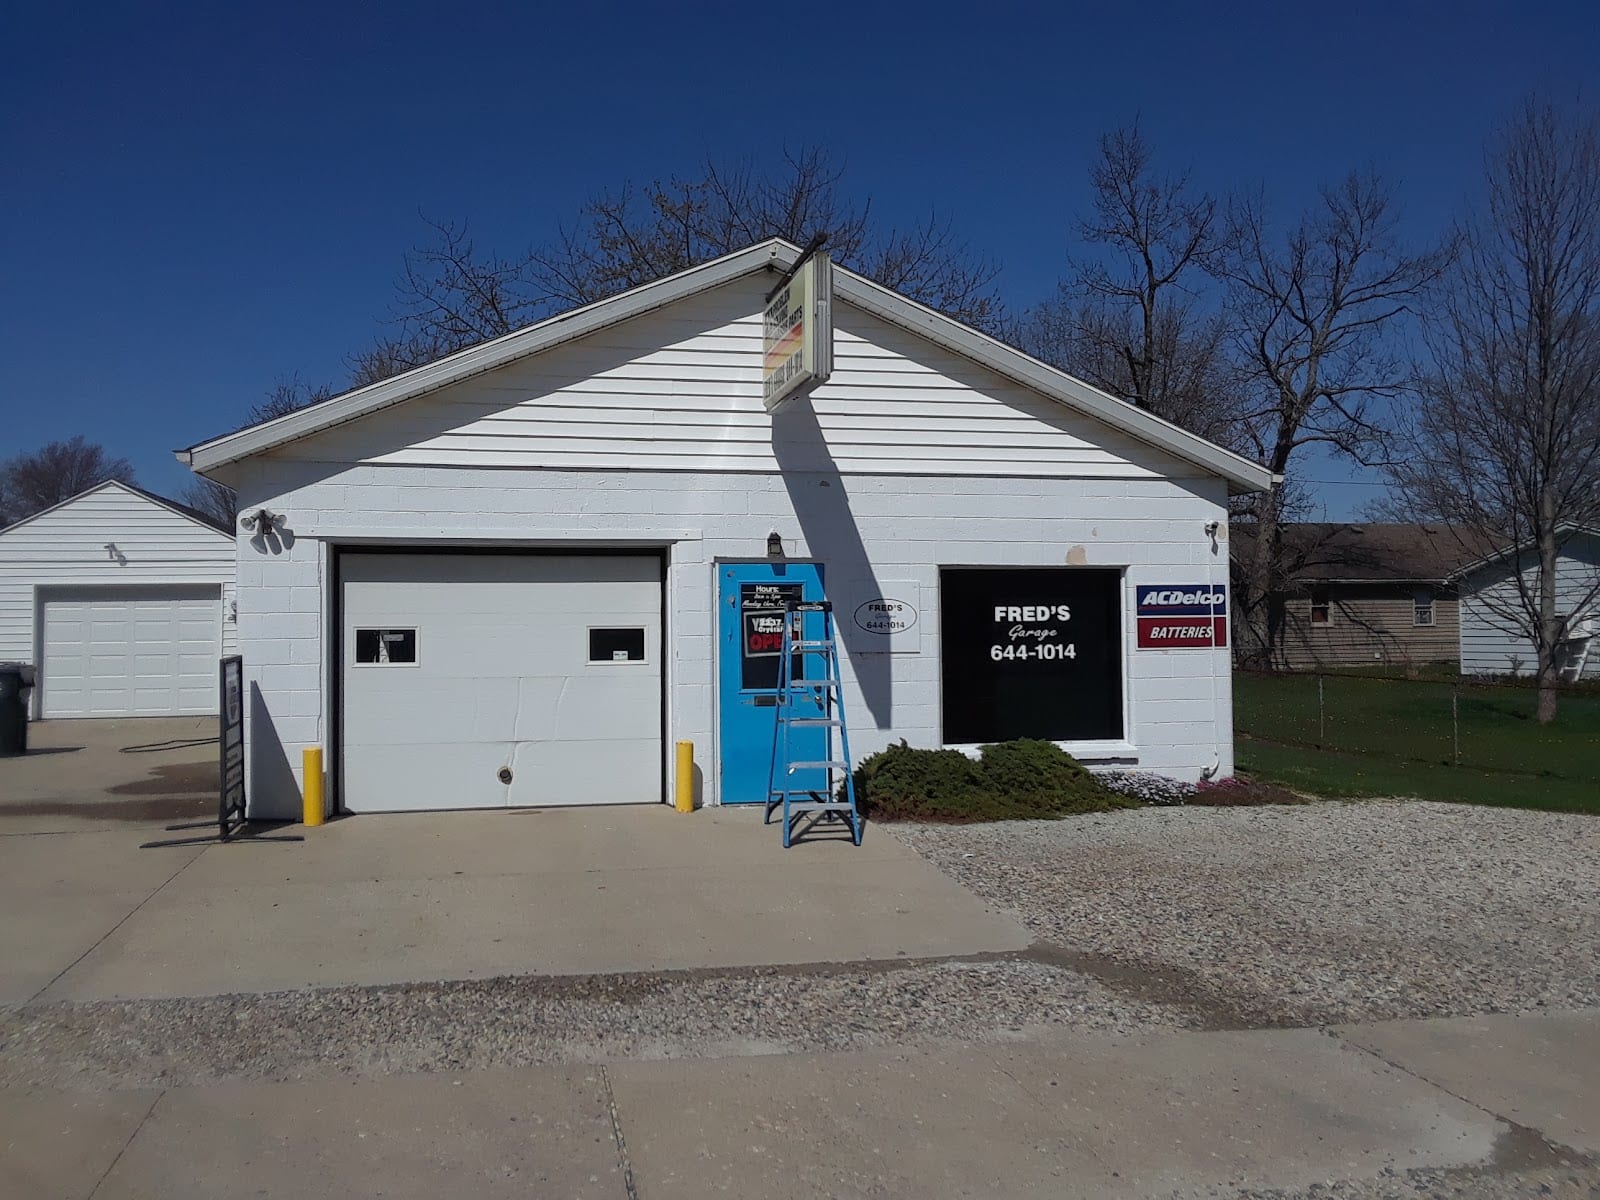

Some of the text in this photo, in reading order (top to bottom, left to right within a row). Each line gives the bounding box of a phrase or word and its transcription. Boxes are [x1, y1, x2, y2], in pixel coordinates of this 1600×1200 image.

[1142, 590, 1225, 605] ACDelco
[868, 604, 903, 612] FRED'S
[994, 605, 1071, 622] FRED'S
[866, 621, 905, 629] 644-1014
[1008, 624, 1058, 641] Garage
[1150, 626, 1213, 639] BATTERIES
[990, 643, 1077, 661] 644-1014
